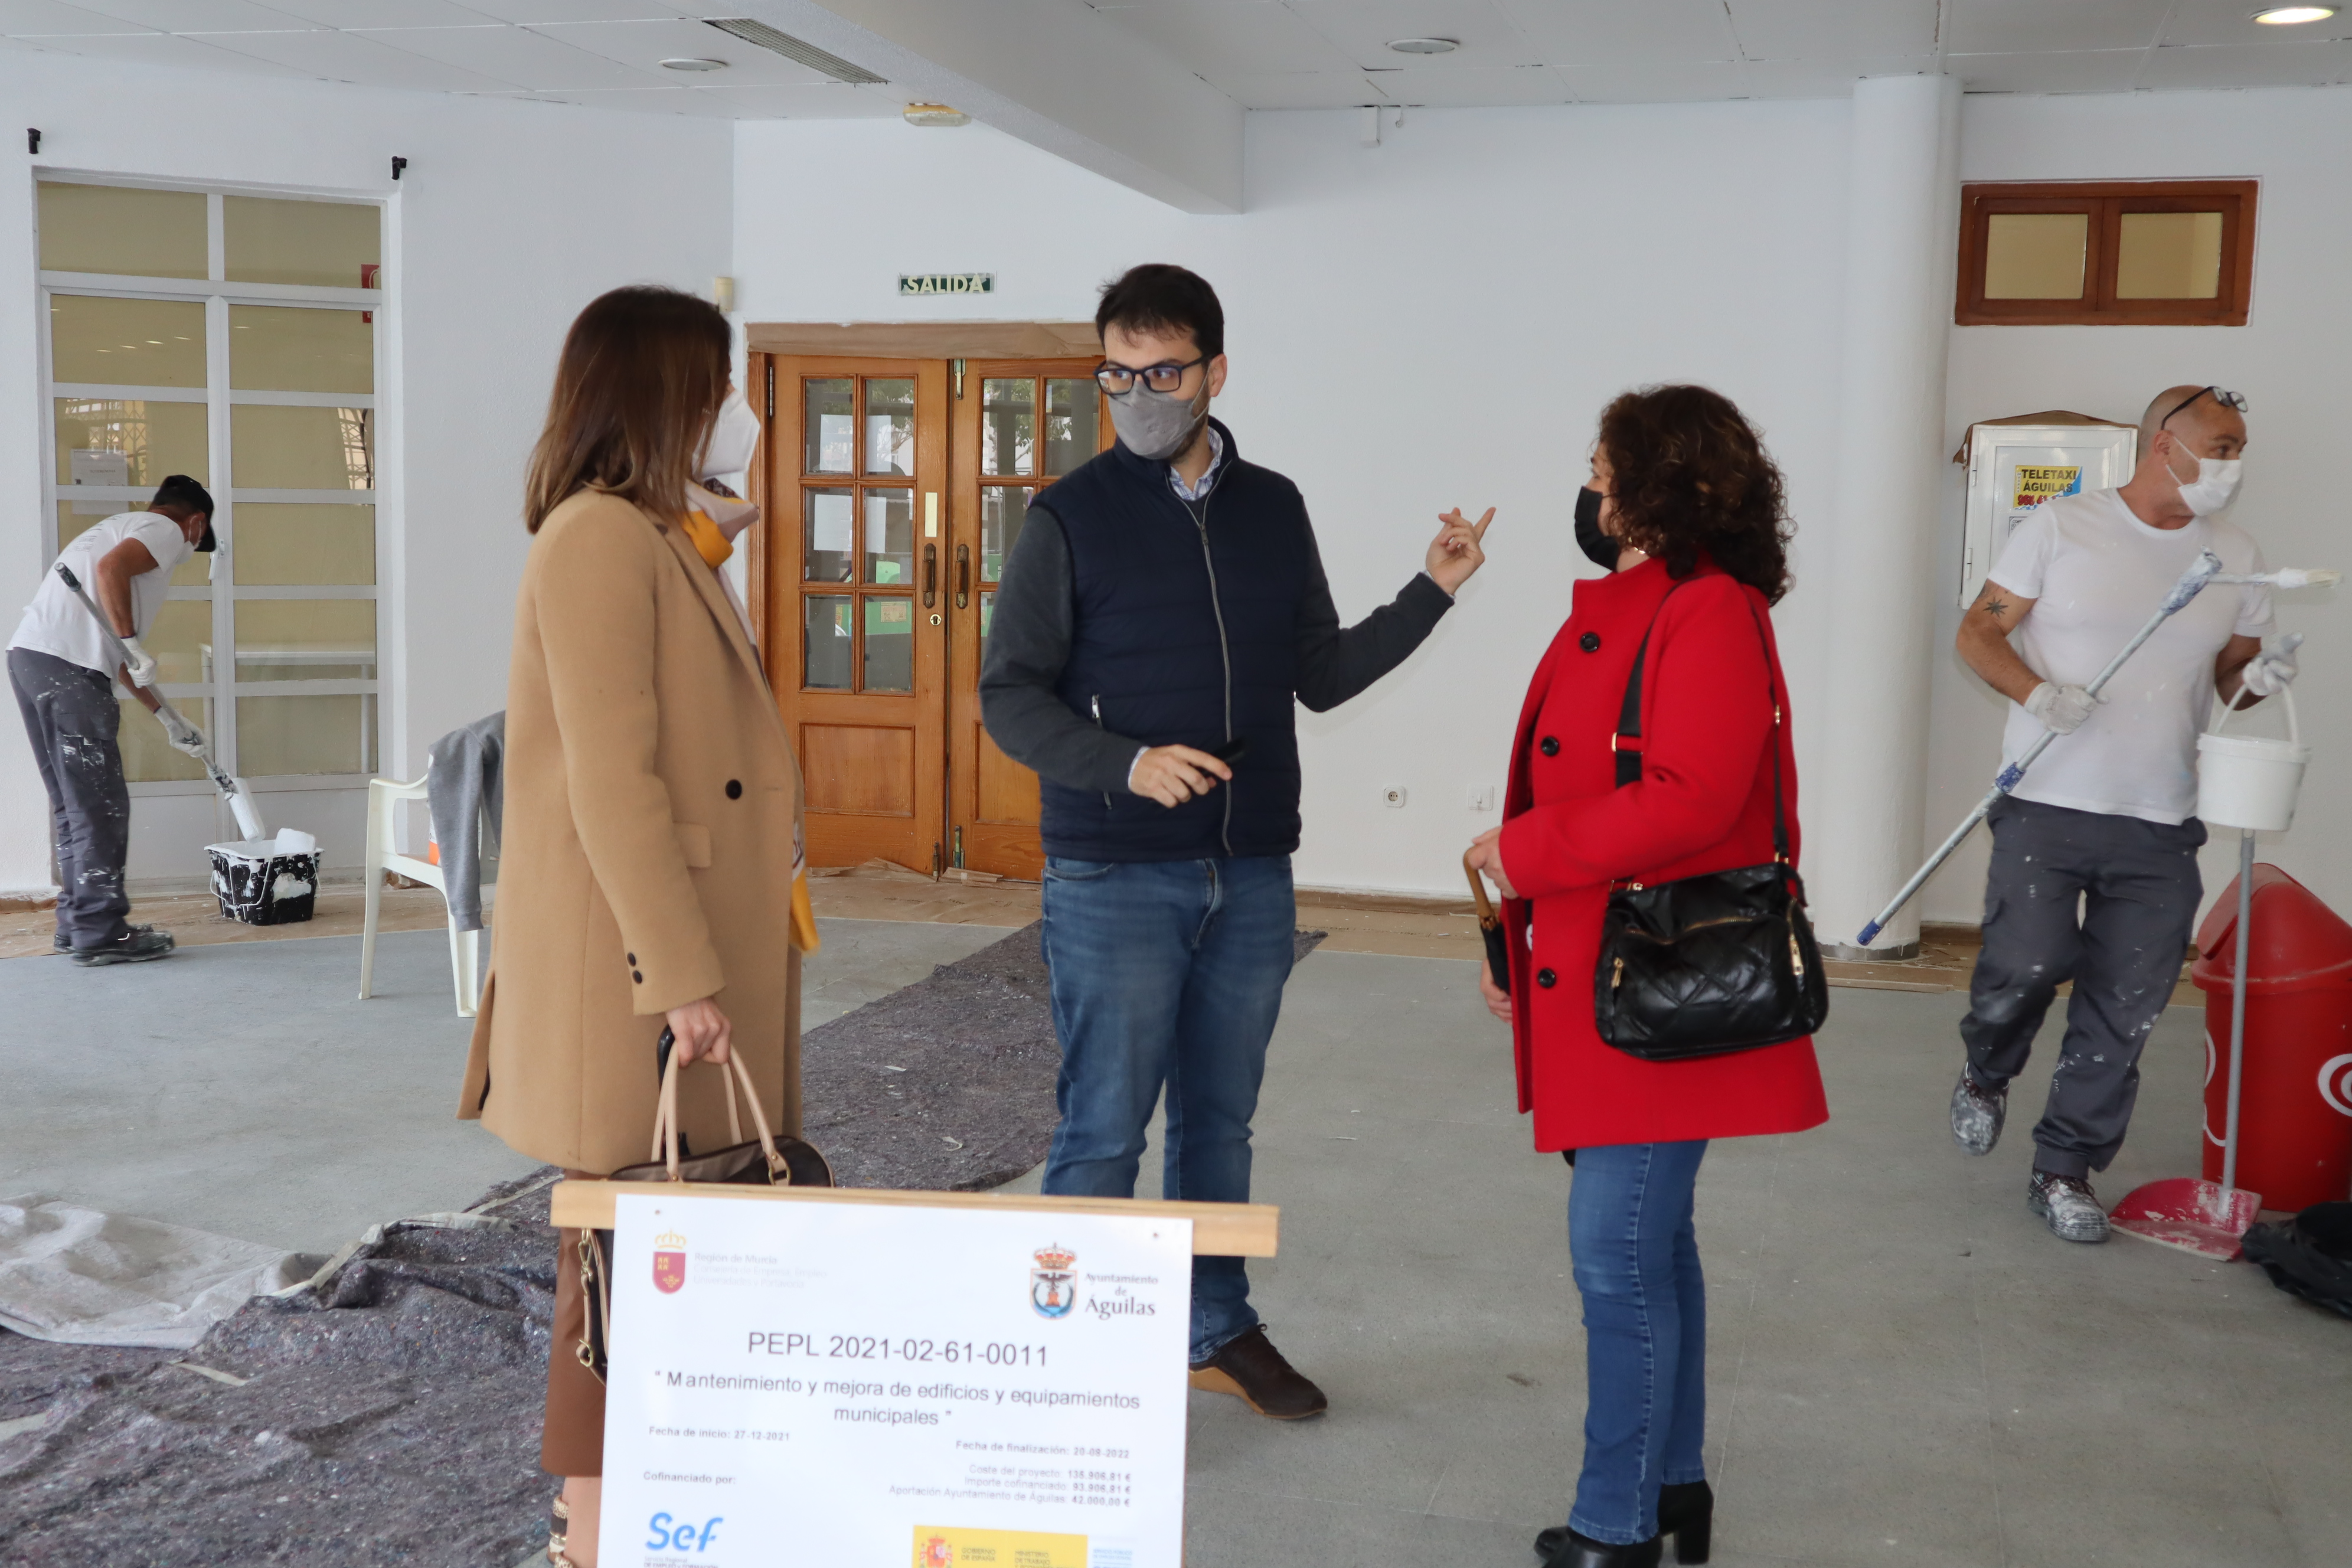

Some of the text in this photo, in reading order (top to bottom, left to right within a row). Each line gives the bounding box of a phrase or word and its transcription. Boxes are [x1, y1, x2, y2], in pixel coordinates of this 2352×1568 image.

[907, 274, 984, 295] SALIDA
[2021, 469, 2077, 479] TELETAXI
[2023, 480, 2073, 492] ÁGUILAS
[695, 1252, 778, 1265] Región de Murcia
[740, 1266, 752, 1275] de
[1084, 1273, 1158, 1286] Ayuntamiento
[1115, 1286, 1127, 1296] de
[1084, 1294, 1156, 1321] Águilas
[747, 1332, 1047, 1367] PEPL 2021-02-61-0011
[667, 1371, 802, 1393] Mantenimiento
[808, 1381, 818, 1397] y
[824, 1379, 883, 1399] mejora
[890, 1381, 911, 1398] de
[917, 1383, 989, 1401] edificios
[995, 1389, 1005, 1405] y
[1011, 1388, 1140, 1409] equipamientos
[834, 1407, 939, 1427] municipales
[649, 1426, 790, 1442] Fecha de inicio: 27-12-2021
[956, 1440, 1129, 1459] Fecha de finalización: 20-08-2022
[643, 1471, 736, 1486] Cofinanciado por:
[969, 1464, 998, 1475] Coste
[1000, 1466, 1015, 1475] del
[1018, 1468, 1063, 1479] proyecto:
[1125, 1473, 1131, 1482] €
[964, 1476, 1131, 1495] Importe cofinanciado: 93.906,81 €
[889, 1484, 1130, 1508] Aportación Ayuntamiento de Águilas: 42.000,00 €
[644, 1511, 724, 1553] Sef
